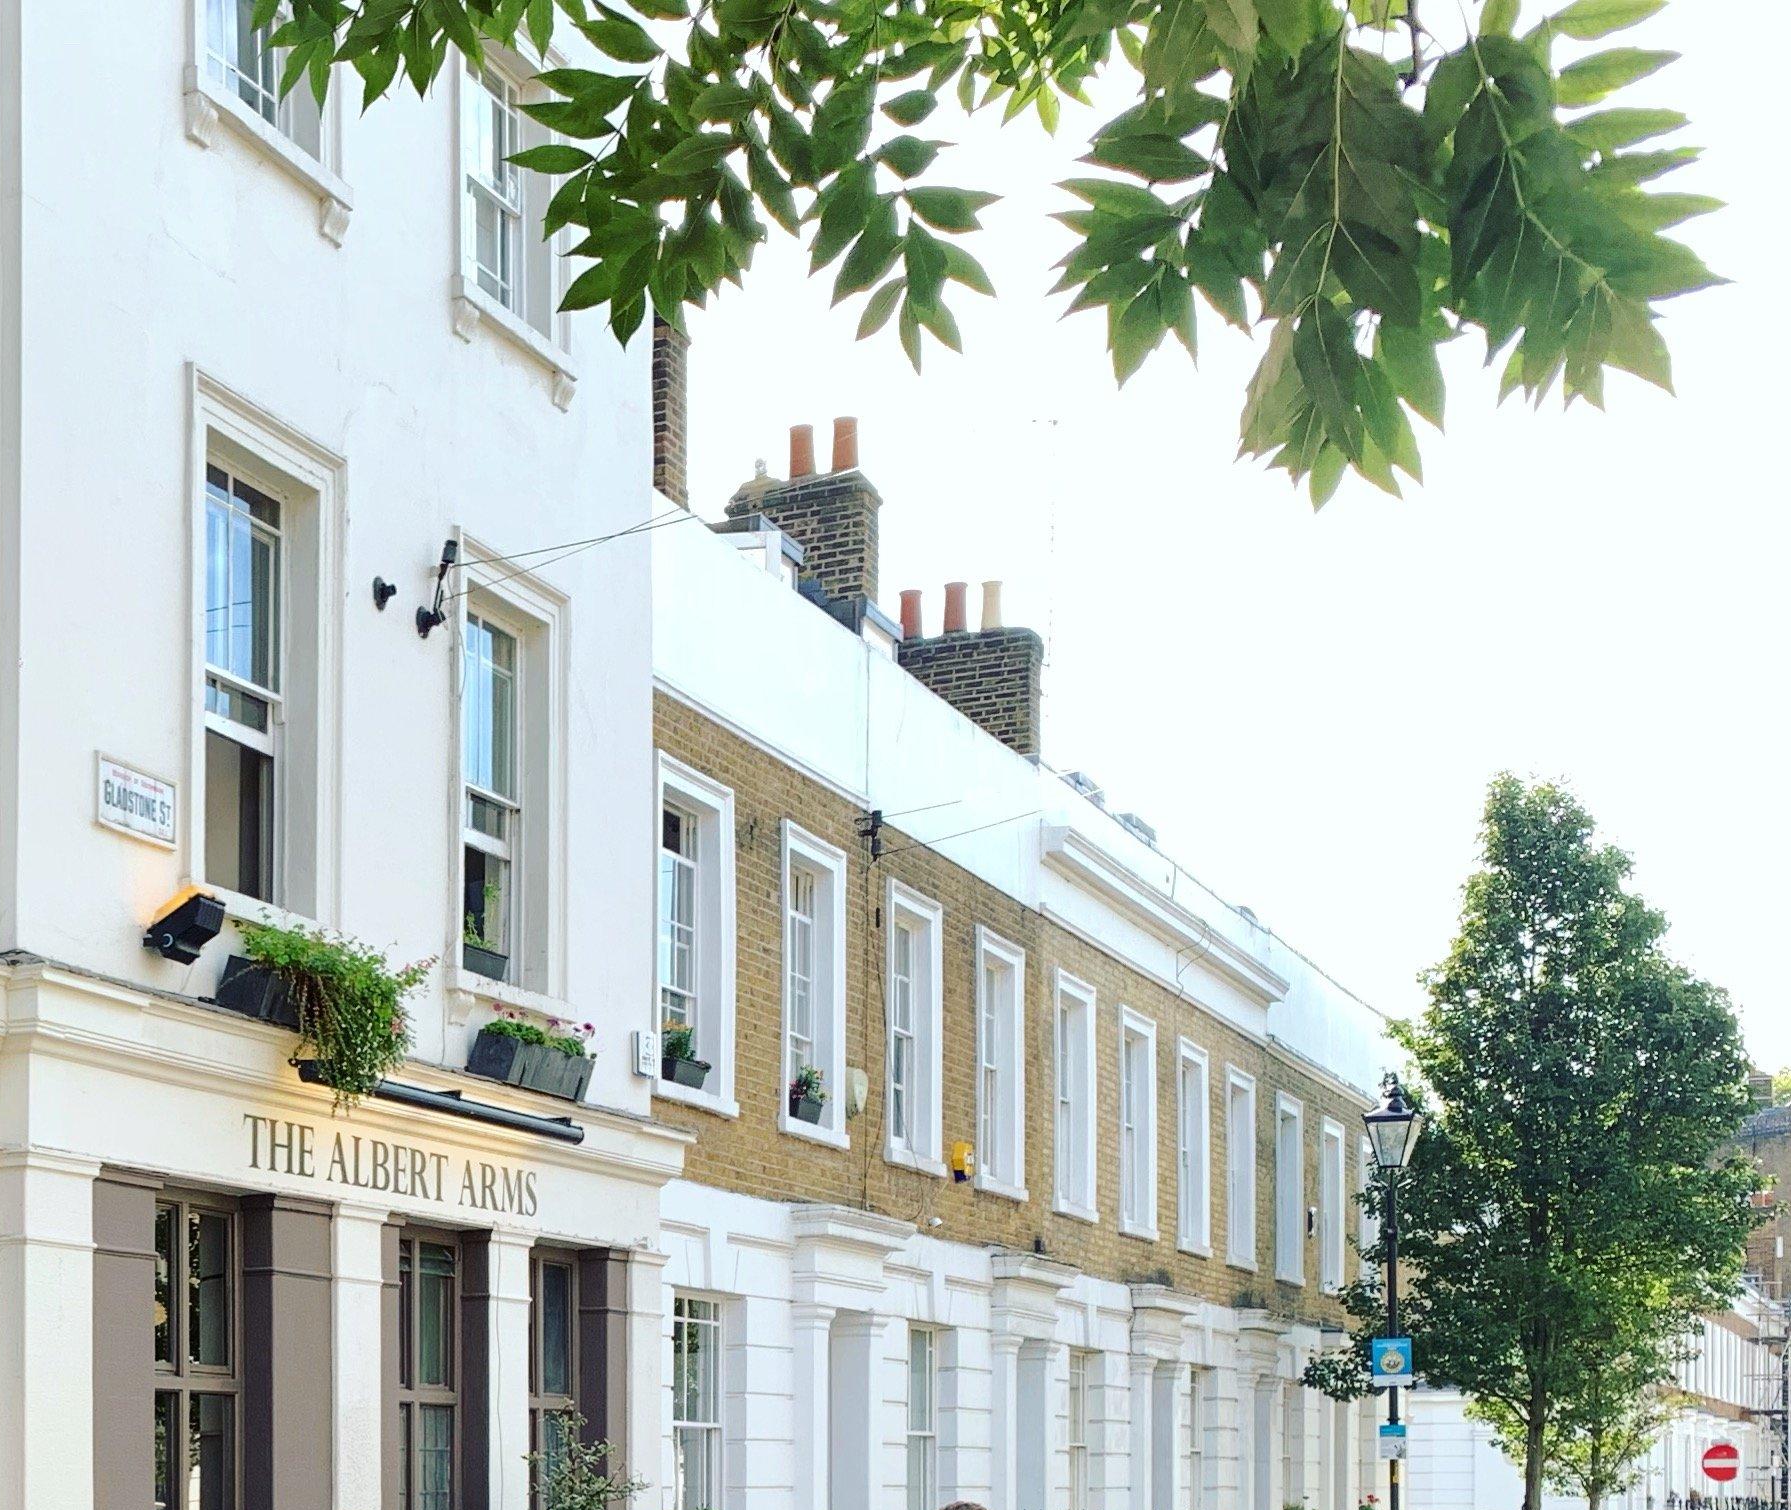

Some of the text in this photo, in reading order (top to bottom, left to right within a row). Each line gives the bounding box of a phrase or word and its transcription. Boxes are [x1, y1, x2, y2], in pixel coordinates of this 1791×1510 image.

[104, 779, 156, 822] GLADSTONE
[243, 1113, 538, 1217] THE ALBERT ARMS
